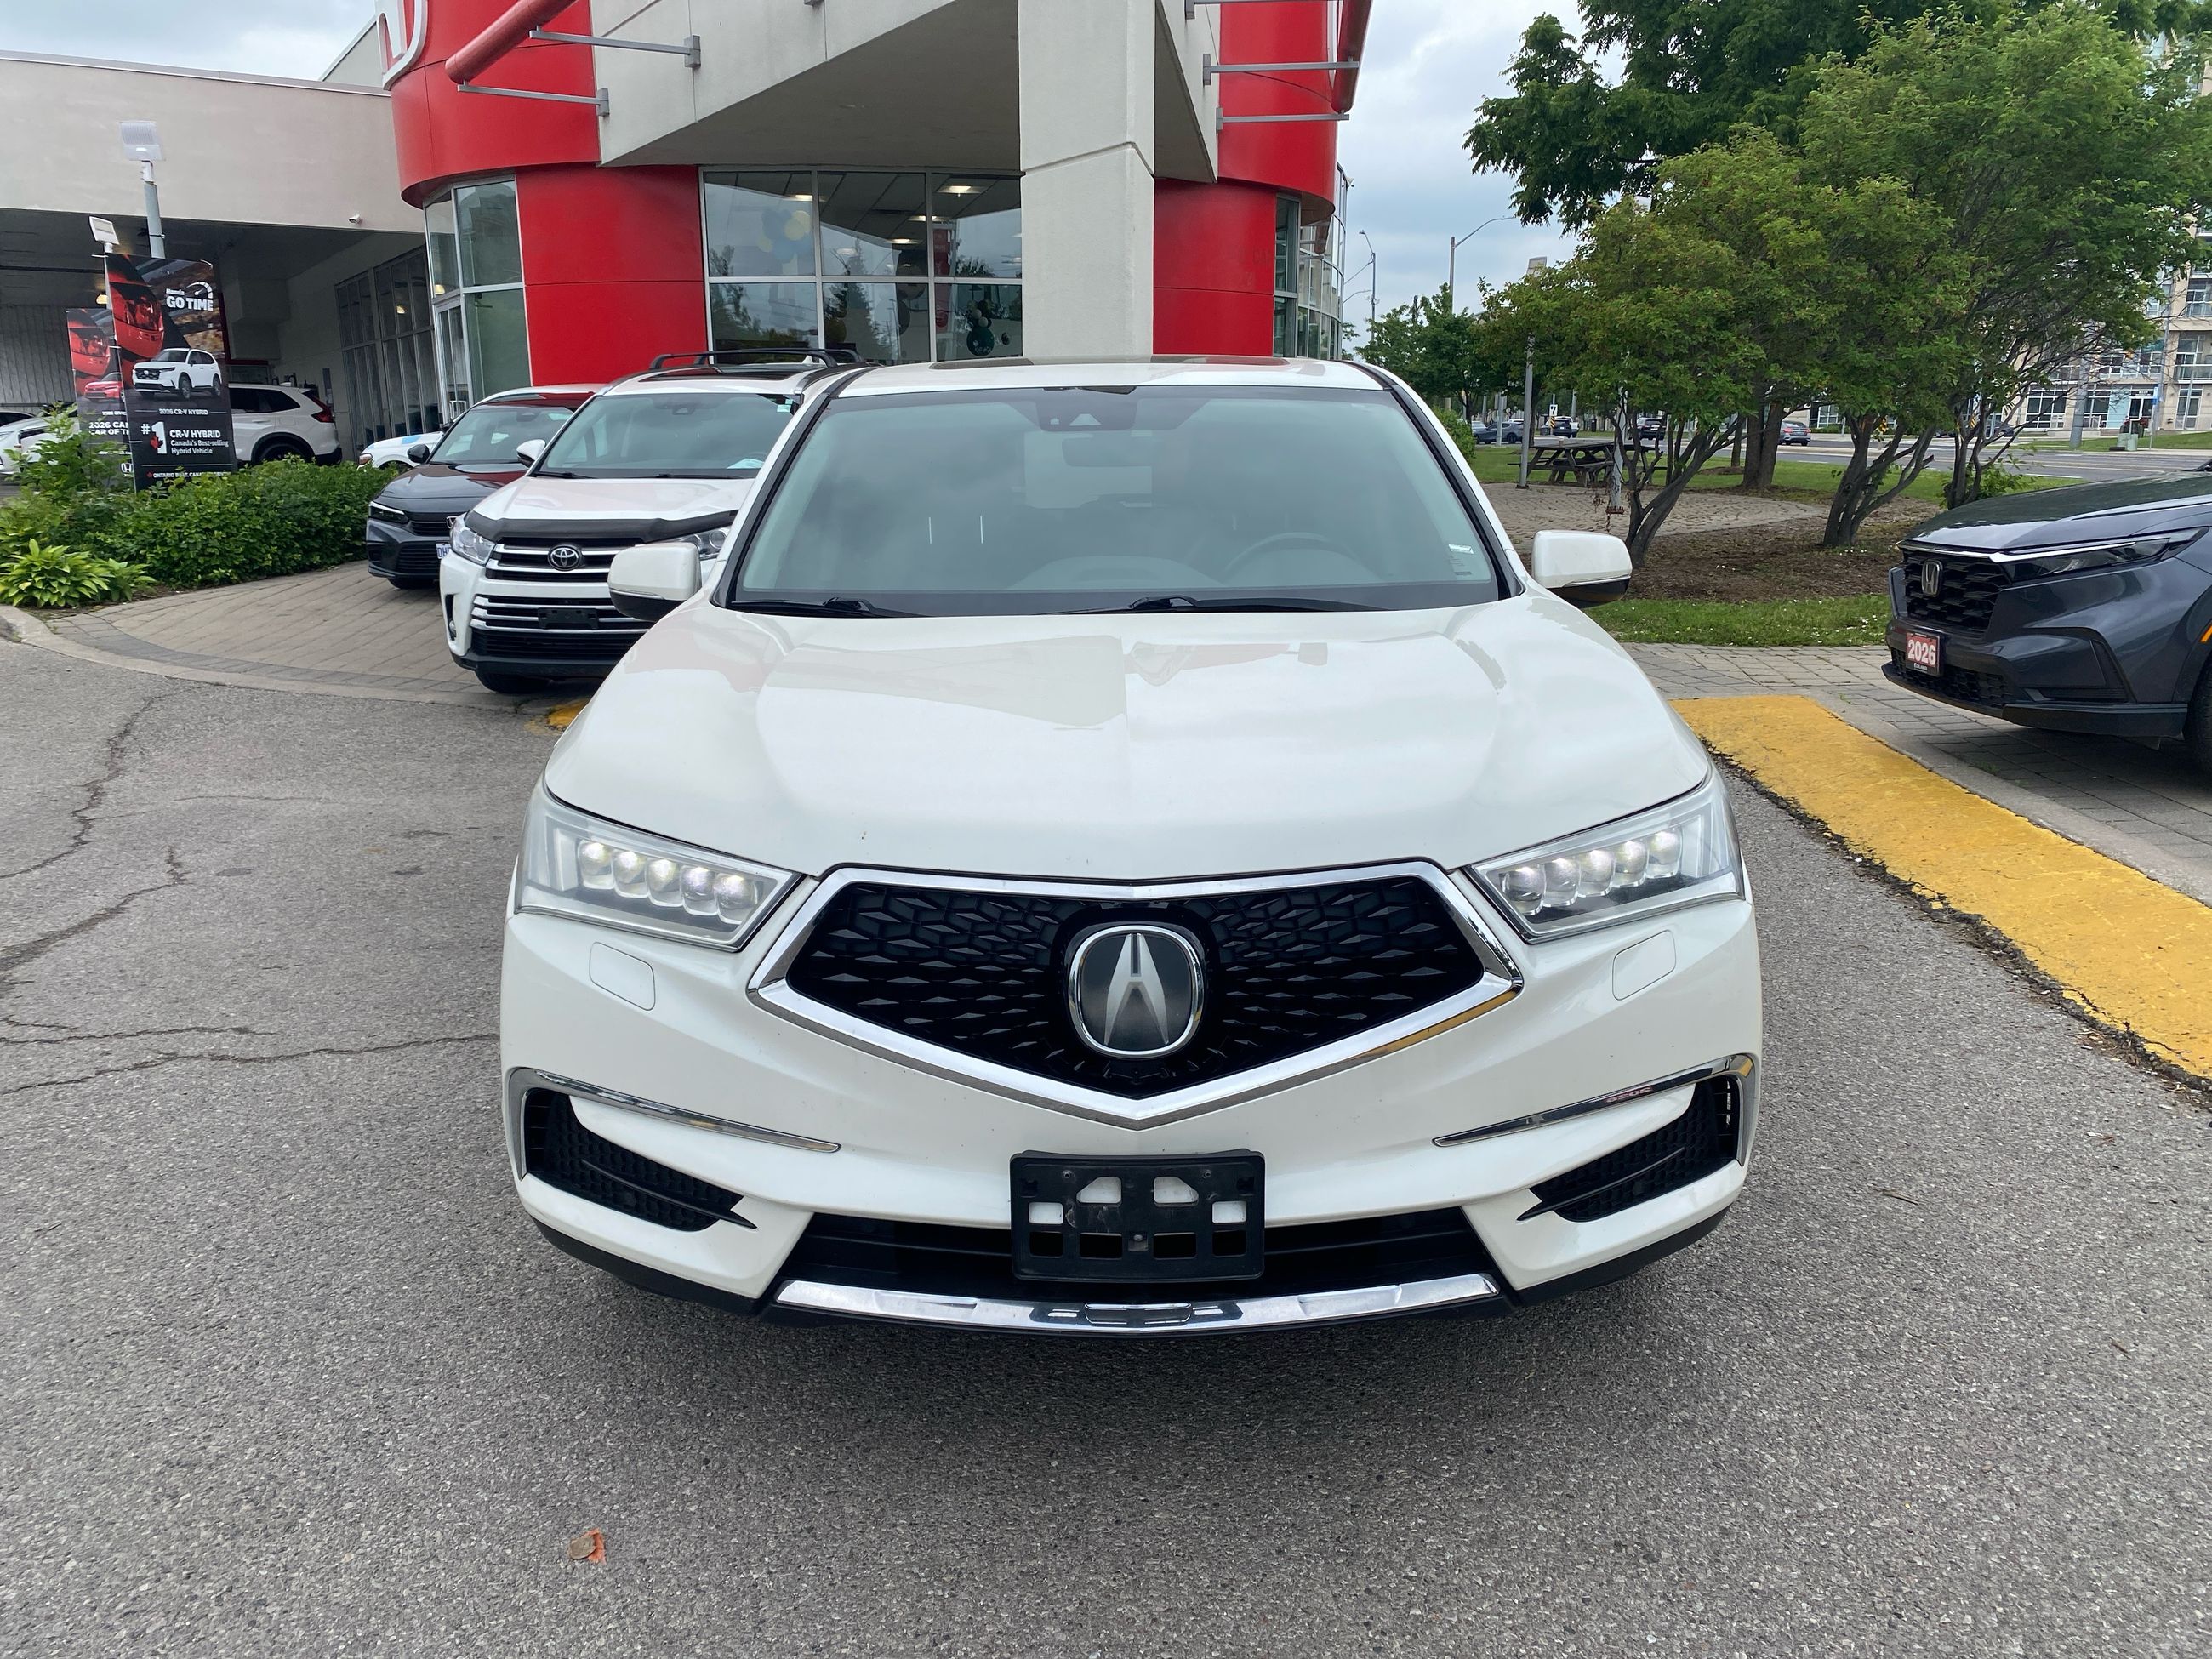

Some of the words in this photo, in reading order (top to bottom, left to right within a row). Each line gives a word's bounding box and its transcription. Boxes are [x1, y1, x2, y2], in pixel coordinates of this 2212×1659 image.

[166, 295, 185, 308] GO
[185, 297, 214, 311] TIME
[169, 430, 190, 438] CR-V
[191, 430, 221, 438] HYBRID
[171, 448, 192, 456] Hybrid
[1907, 639, 1936, 665] 2026
